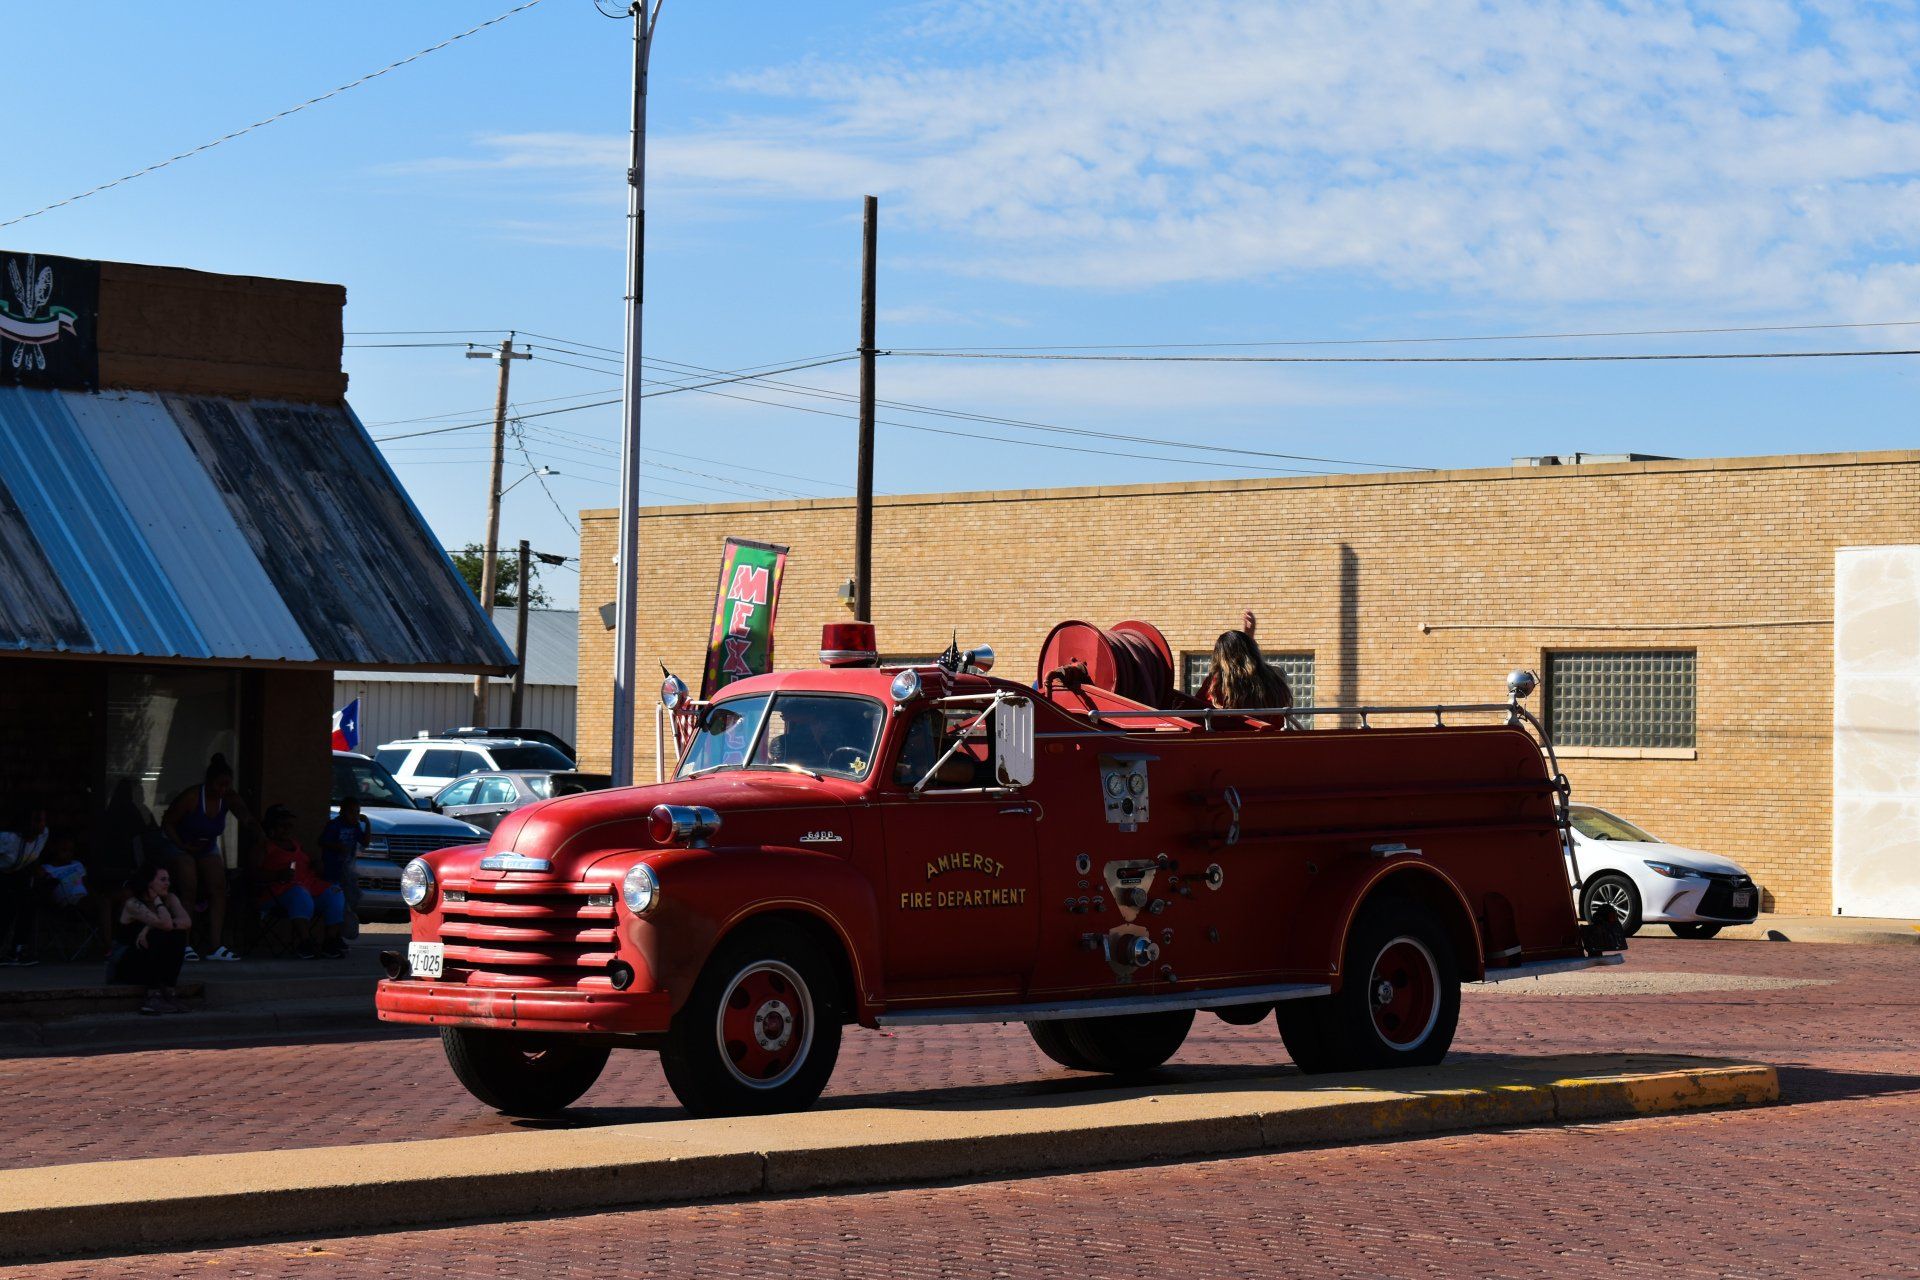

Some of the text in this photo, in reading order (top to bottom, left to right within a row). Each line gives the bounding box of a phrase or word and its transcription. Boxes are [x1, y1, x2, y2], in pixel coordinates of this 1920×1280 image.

[807, 830, 834, 839] 6400
[926, 852, 1004, 879] AMHERST
[901, 888, 1026, 909] FIRE DEPARTMENT
[409, 954, 440, 972] 71-025
